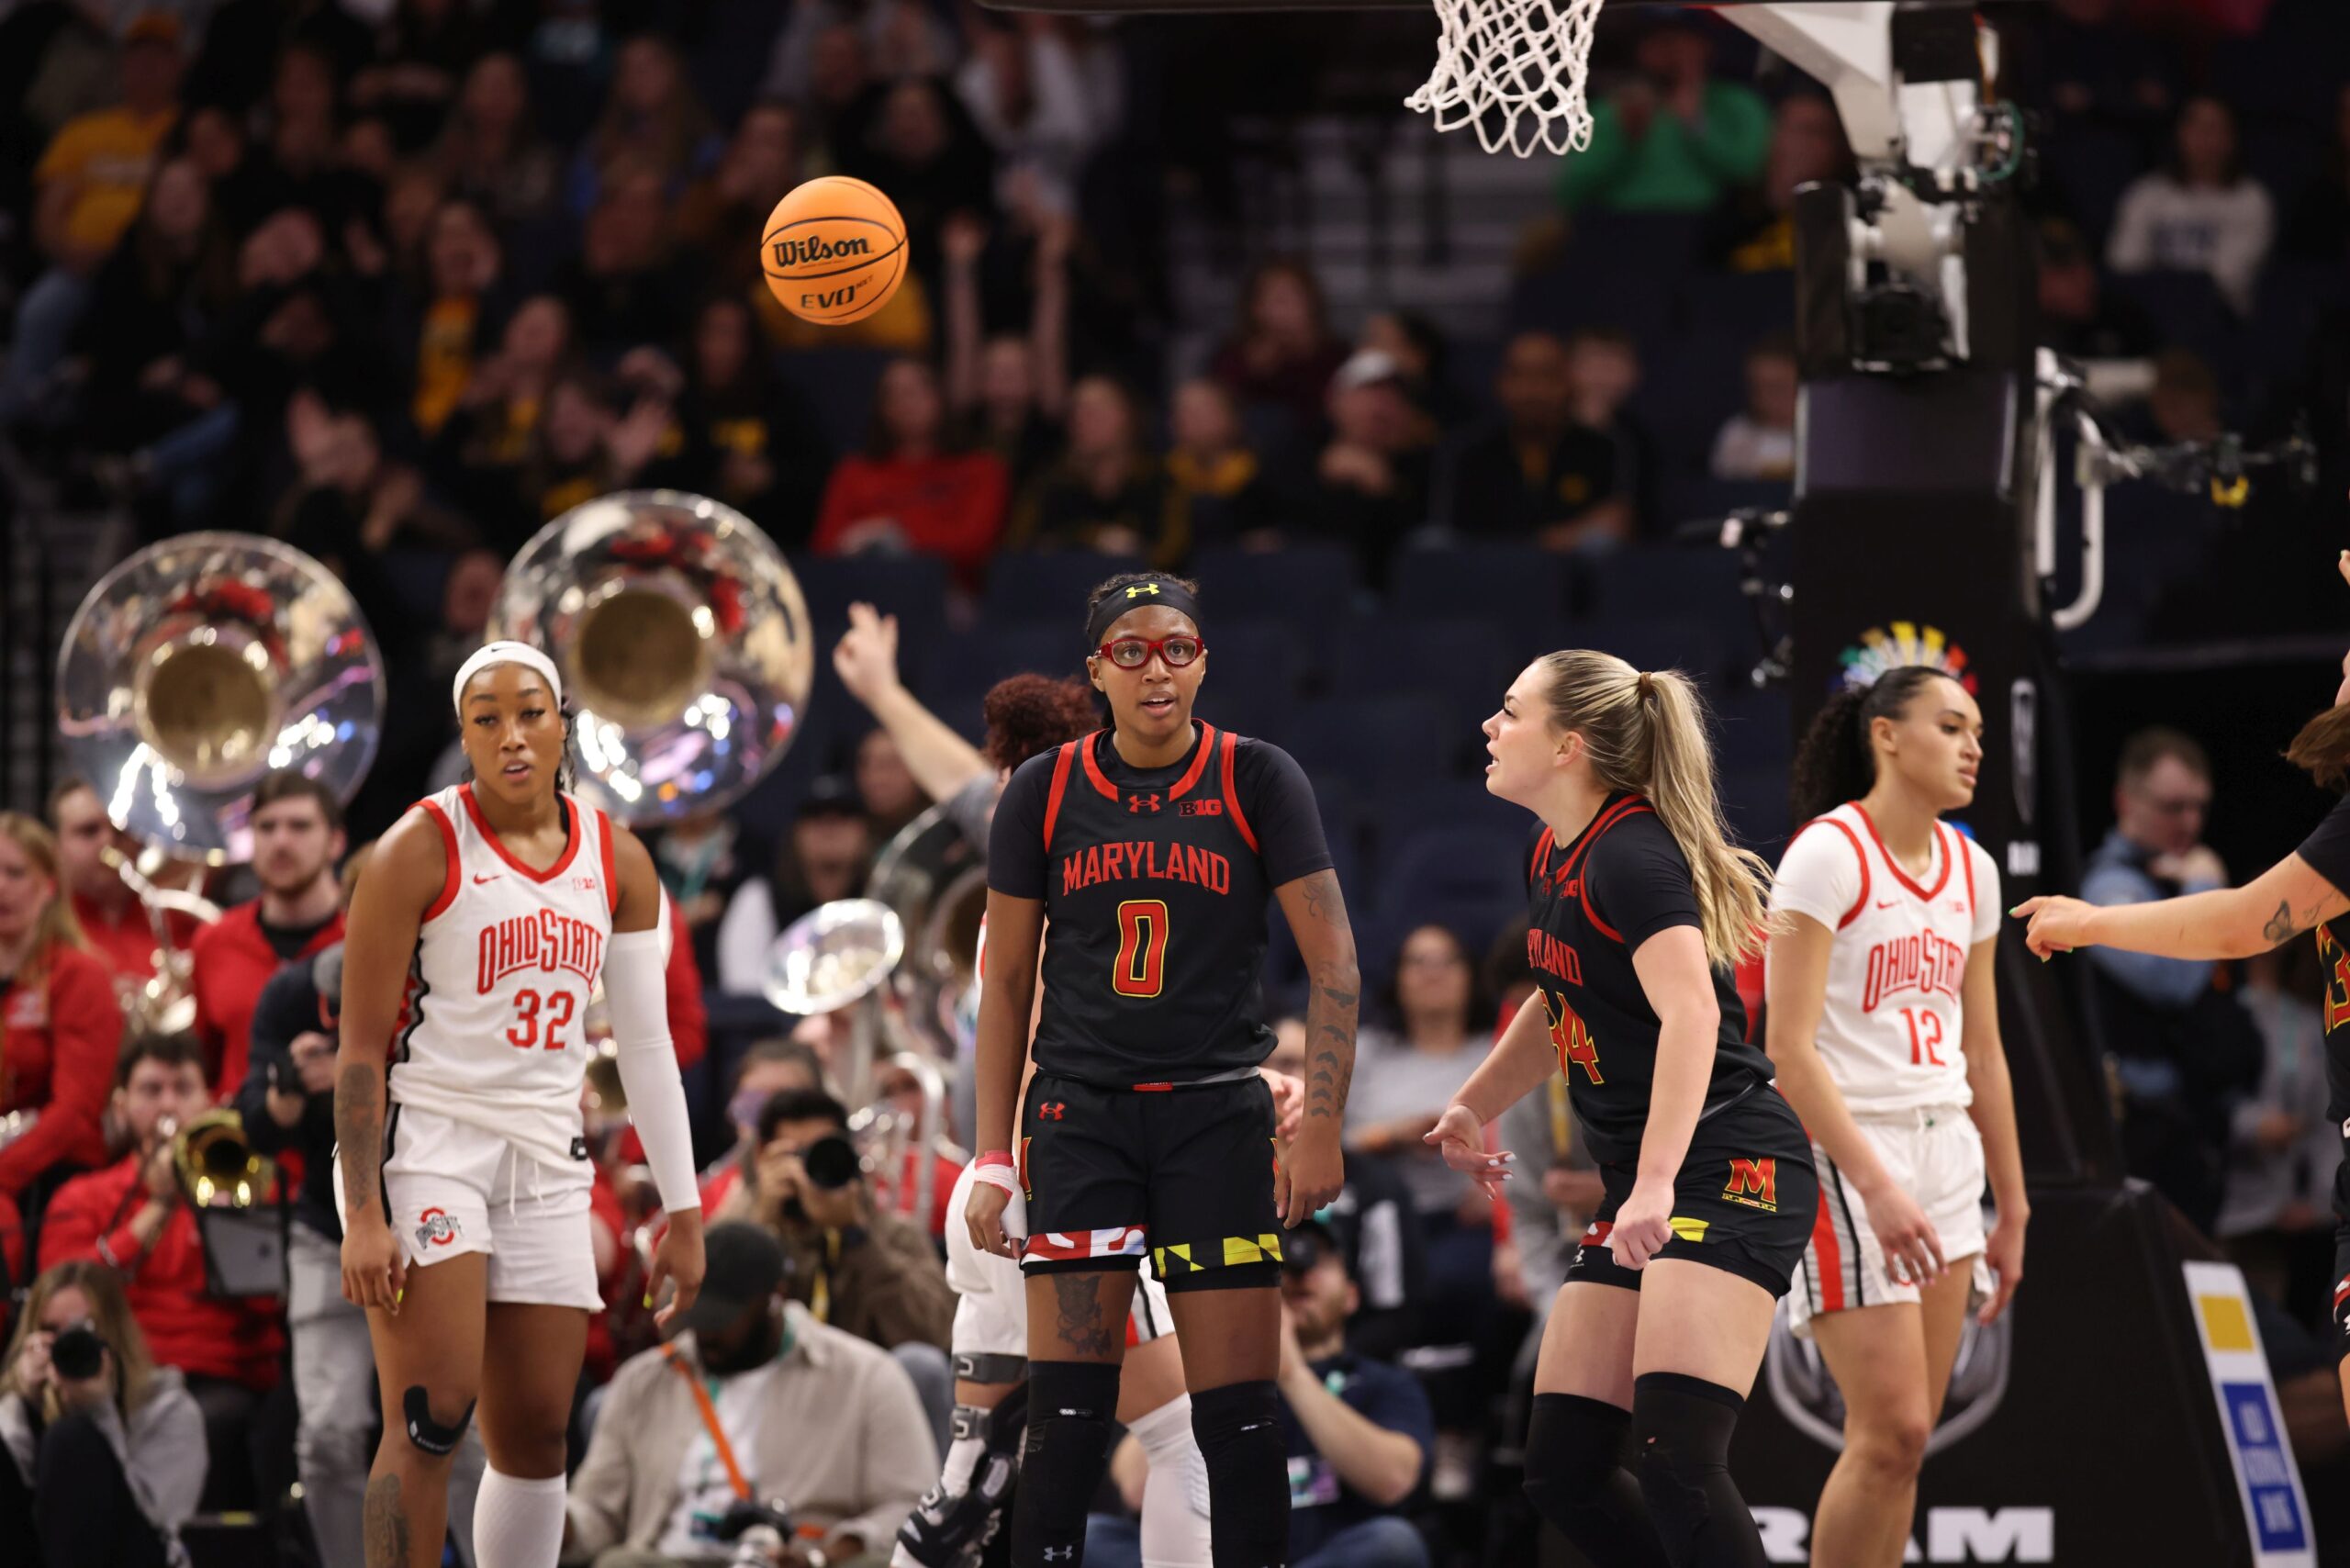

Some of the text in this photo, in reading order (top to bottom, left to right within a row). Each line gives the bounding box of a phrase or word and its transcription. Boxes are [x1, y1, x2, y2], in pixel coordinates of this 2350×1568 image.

[773, 235, 869, 267] Wilson
[801, 286, 855, 308] EVO
[1063, 841, 1229, 896] MARYLAND
[1113, 899, 1169, 998] 0
[507, 989, 574, 1050] 32
[1899, 1007, 1946, 1067] 12
[1725, 1159, 1776, 1204] M
[1748, 1506, 2054, 1562] RM
